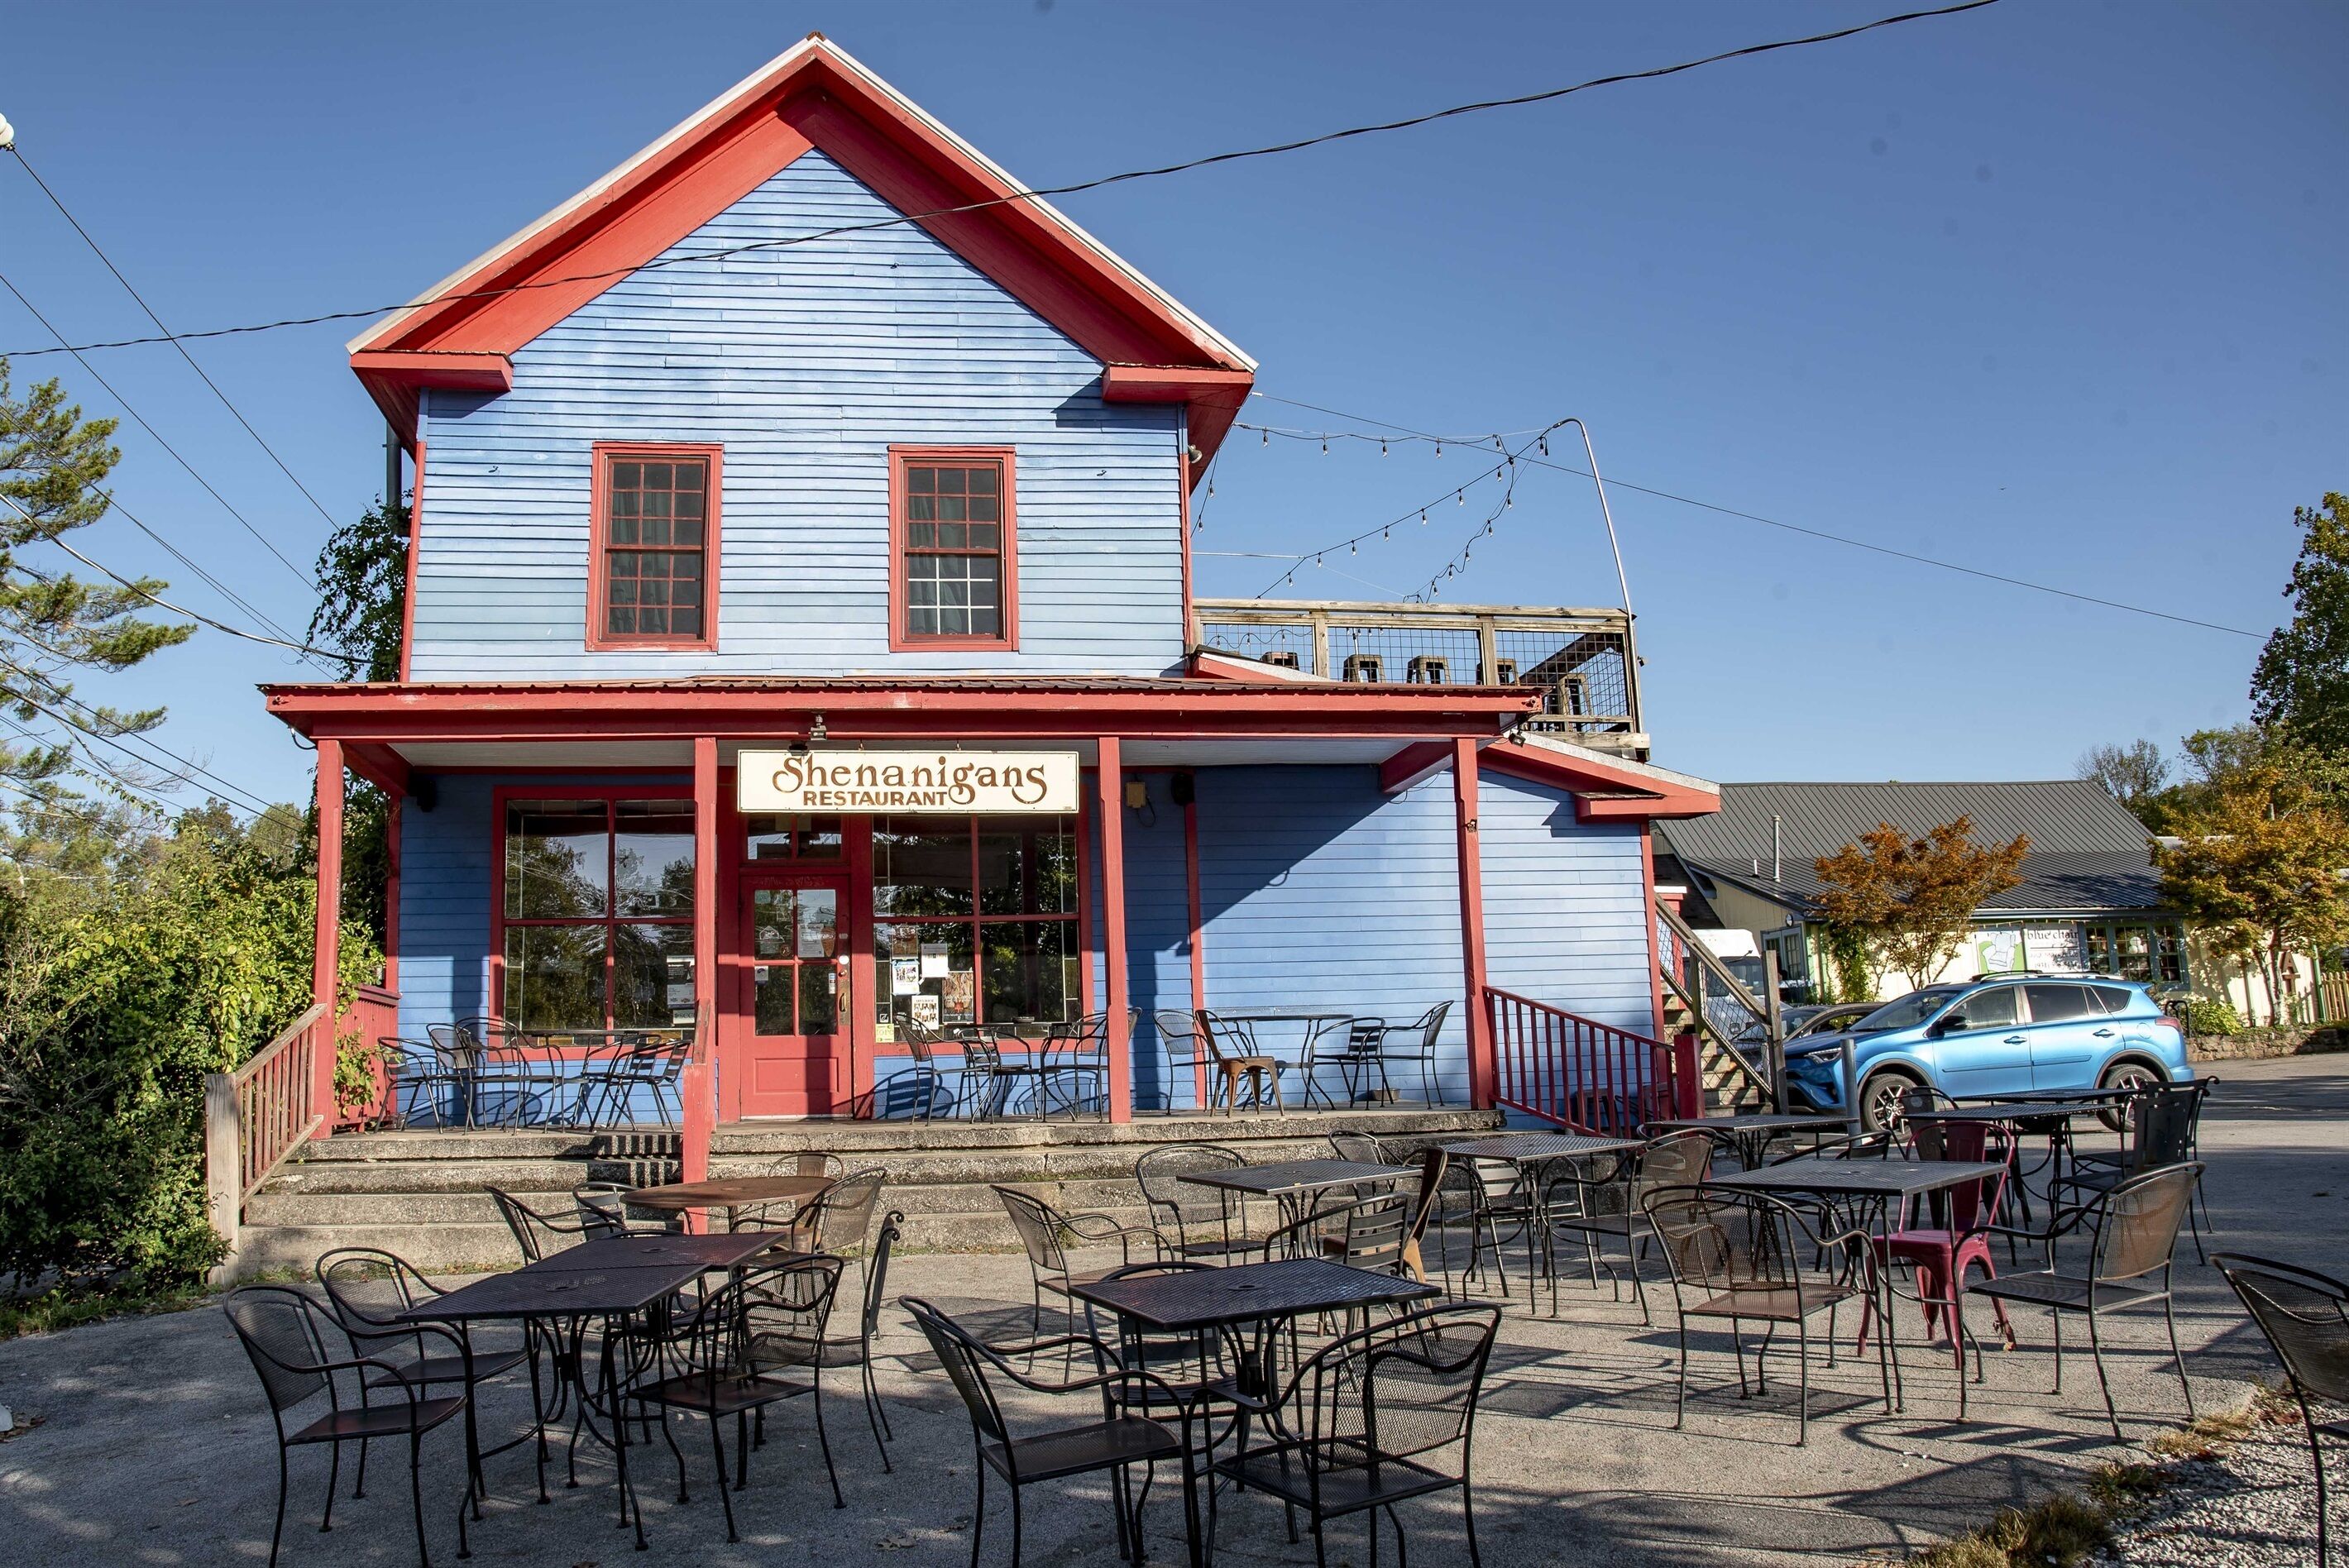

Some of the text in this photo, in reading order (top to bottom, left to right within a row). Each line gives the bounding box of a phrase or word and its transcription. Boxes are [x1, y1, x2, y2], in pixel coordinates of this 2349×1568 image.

[773, 753, 1047, 805] Shenanigans
[802, 791, 948, 806] RESTAURANT
[2027, 928, 2078, 939] blue chair
